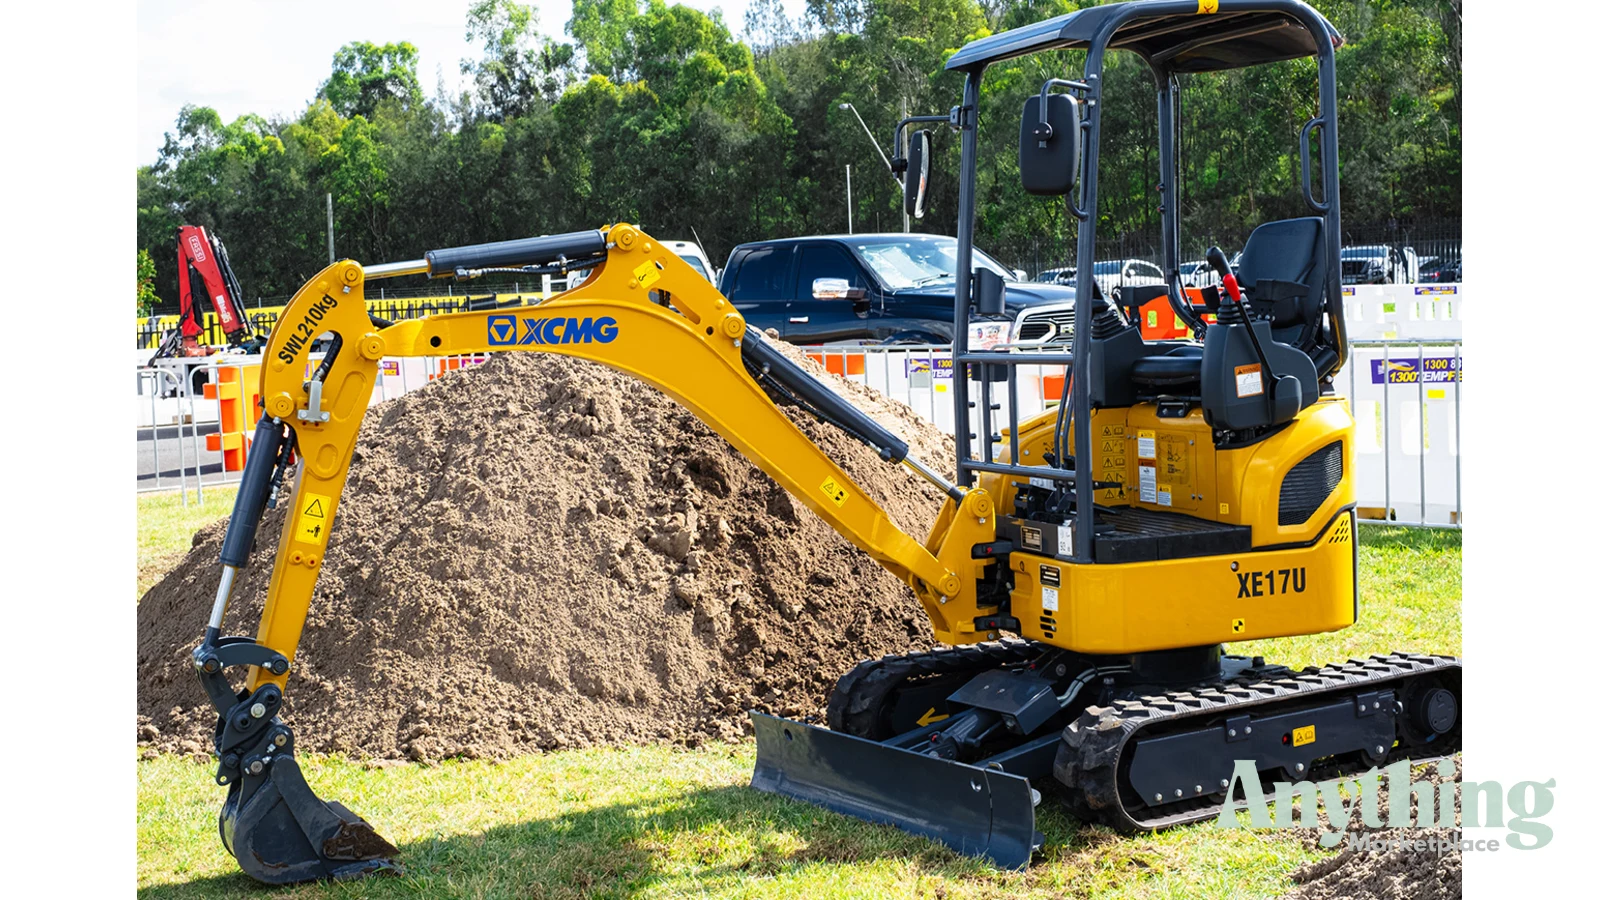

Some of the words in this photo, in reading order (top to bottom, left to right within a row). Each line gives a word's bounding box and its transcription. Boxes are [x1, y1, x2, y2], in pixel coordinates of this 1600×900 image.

[190, 236, 205, 261] FASSI
[278, 293, 338, 365] SWL210kg
[517, 316, 619, 345] XCMG
[1424, 359, 1448, 370] 1300
[1236, 567, 1306, 599] XE17U
